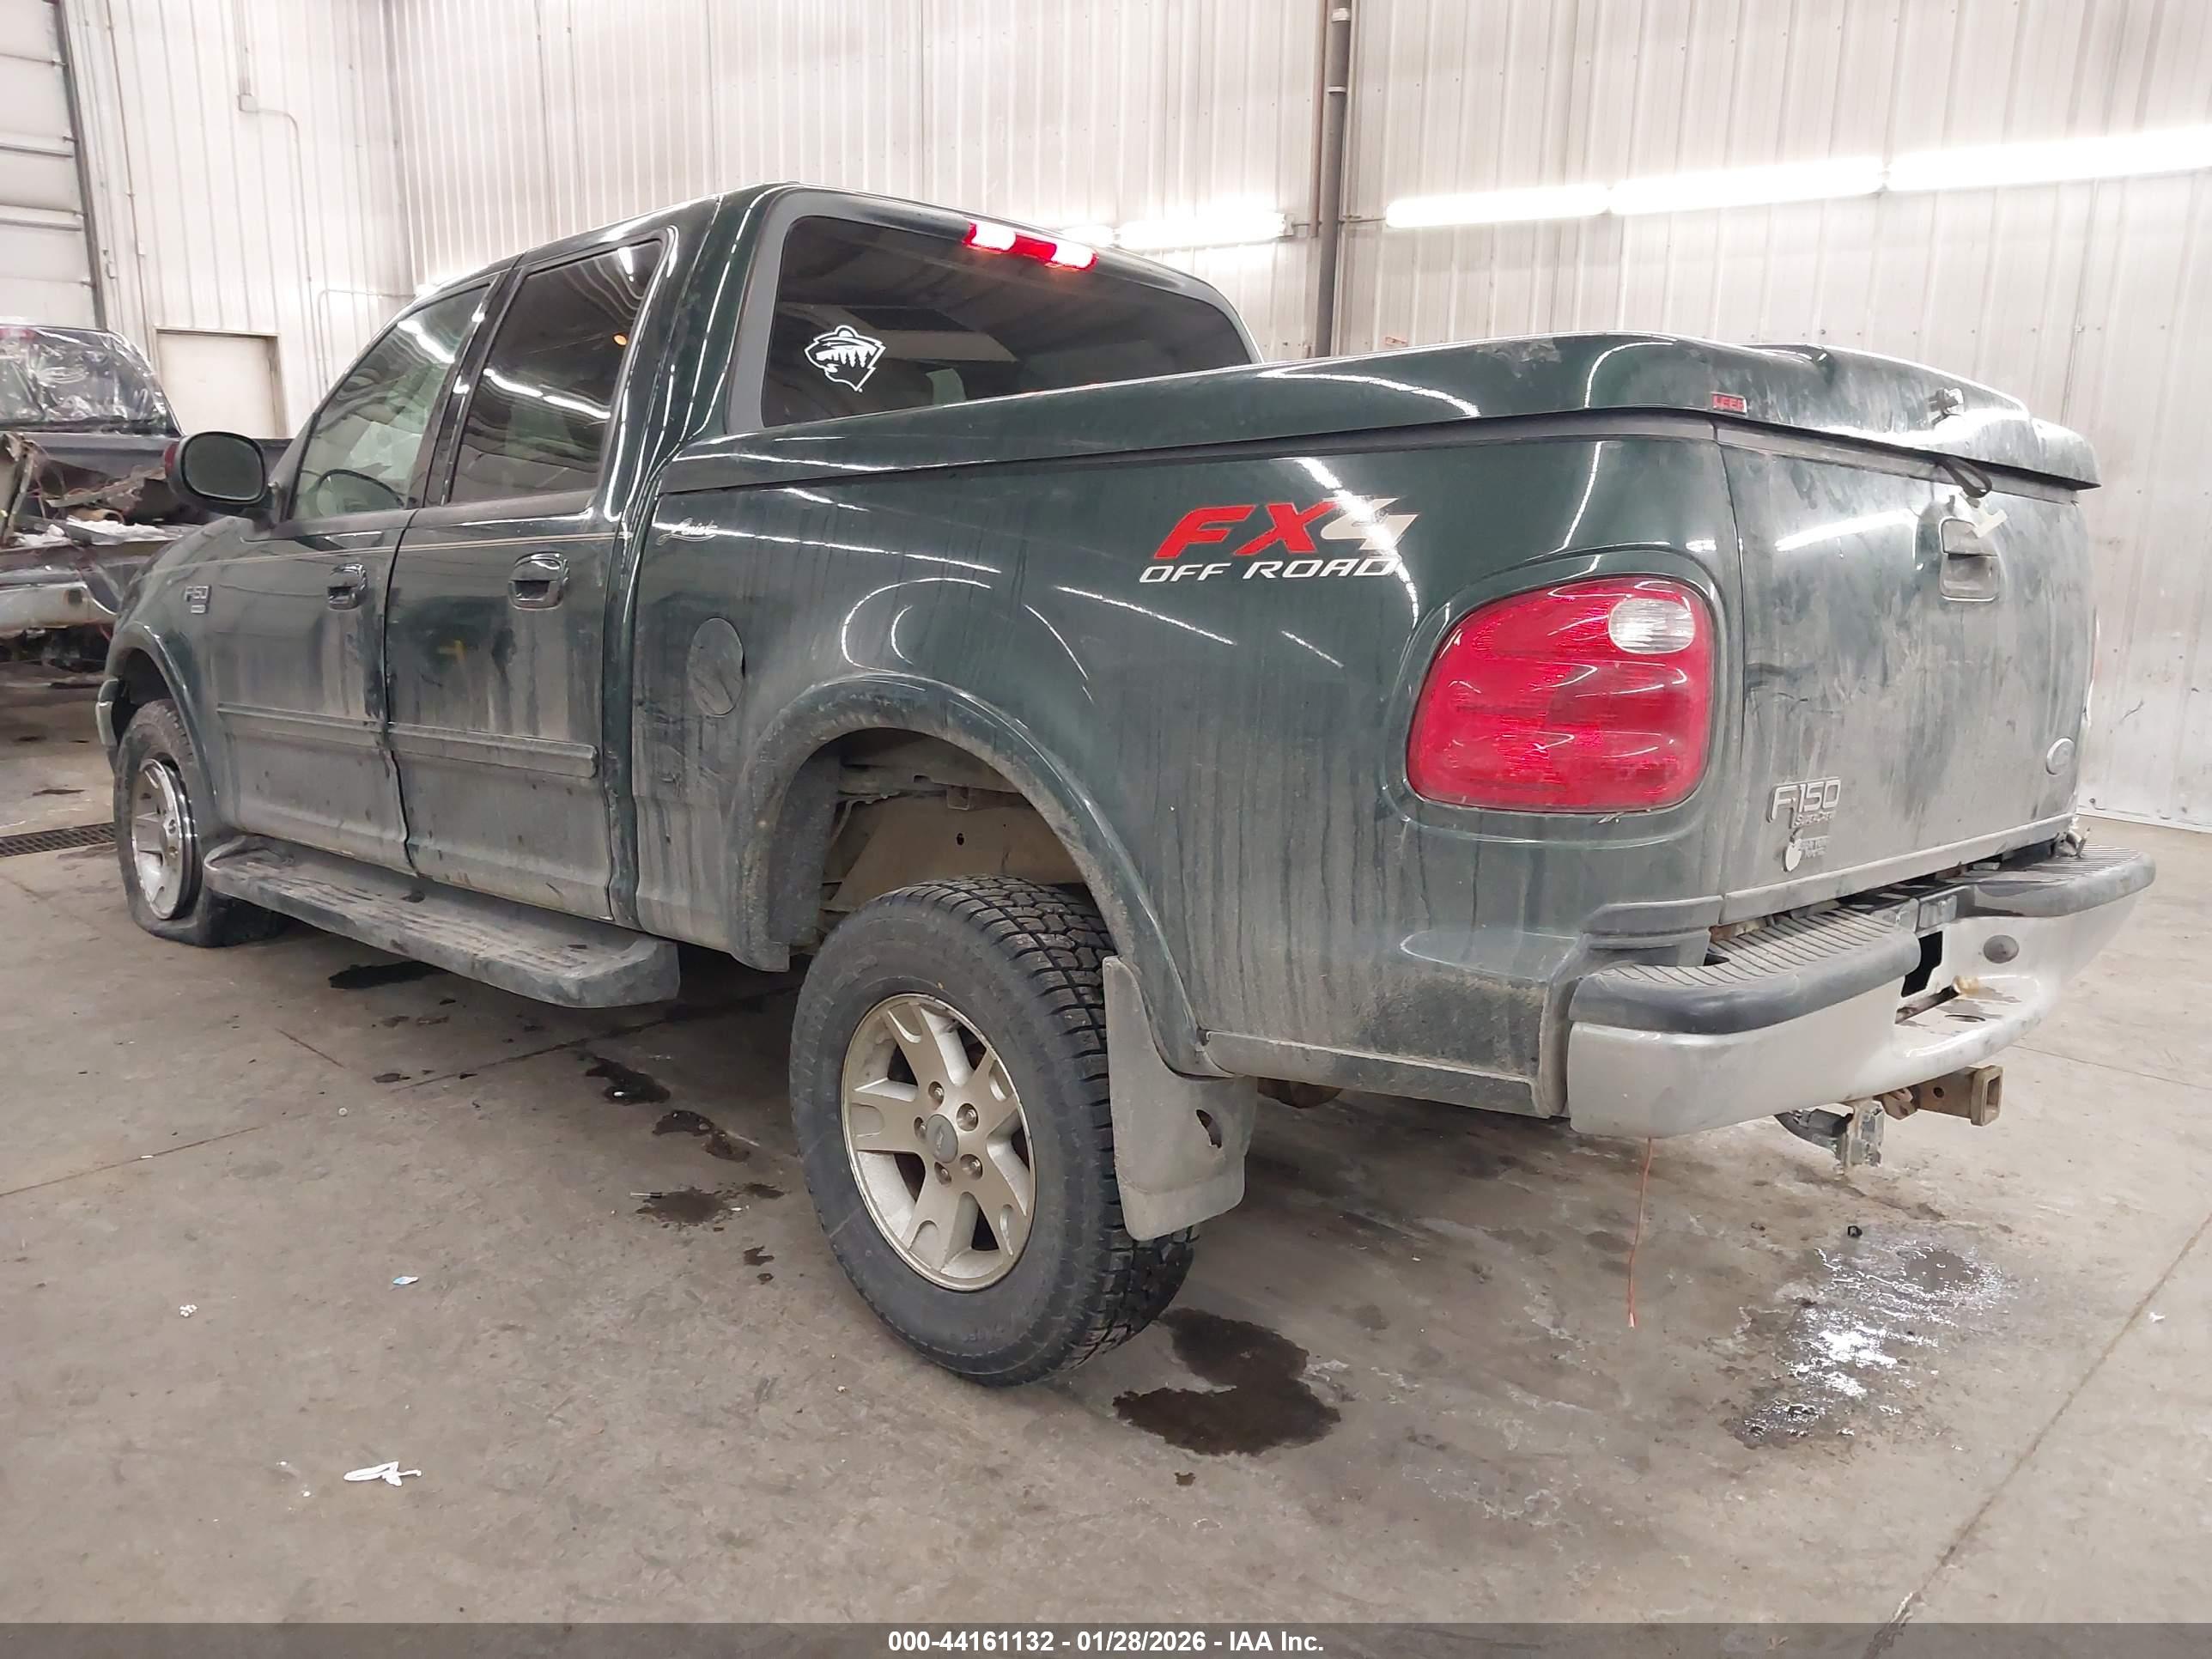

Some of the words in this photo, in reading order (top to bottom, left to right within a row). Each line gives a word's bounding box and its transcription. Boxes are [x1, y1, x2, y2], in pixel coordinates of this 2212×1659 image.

[1154, 497, 1419, 559] FX4
[1139, 562, 1231, 583] OFF
[1243, 558, 1400, 580] ROAD
